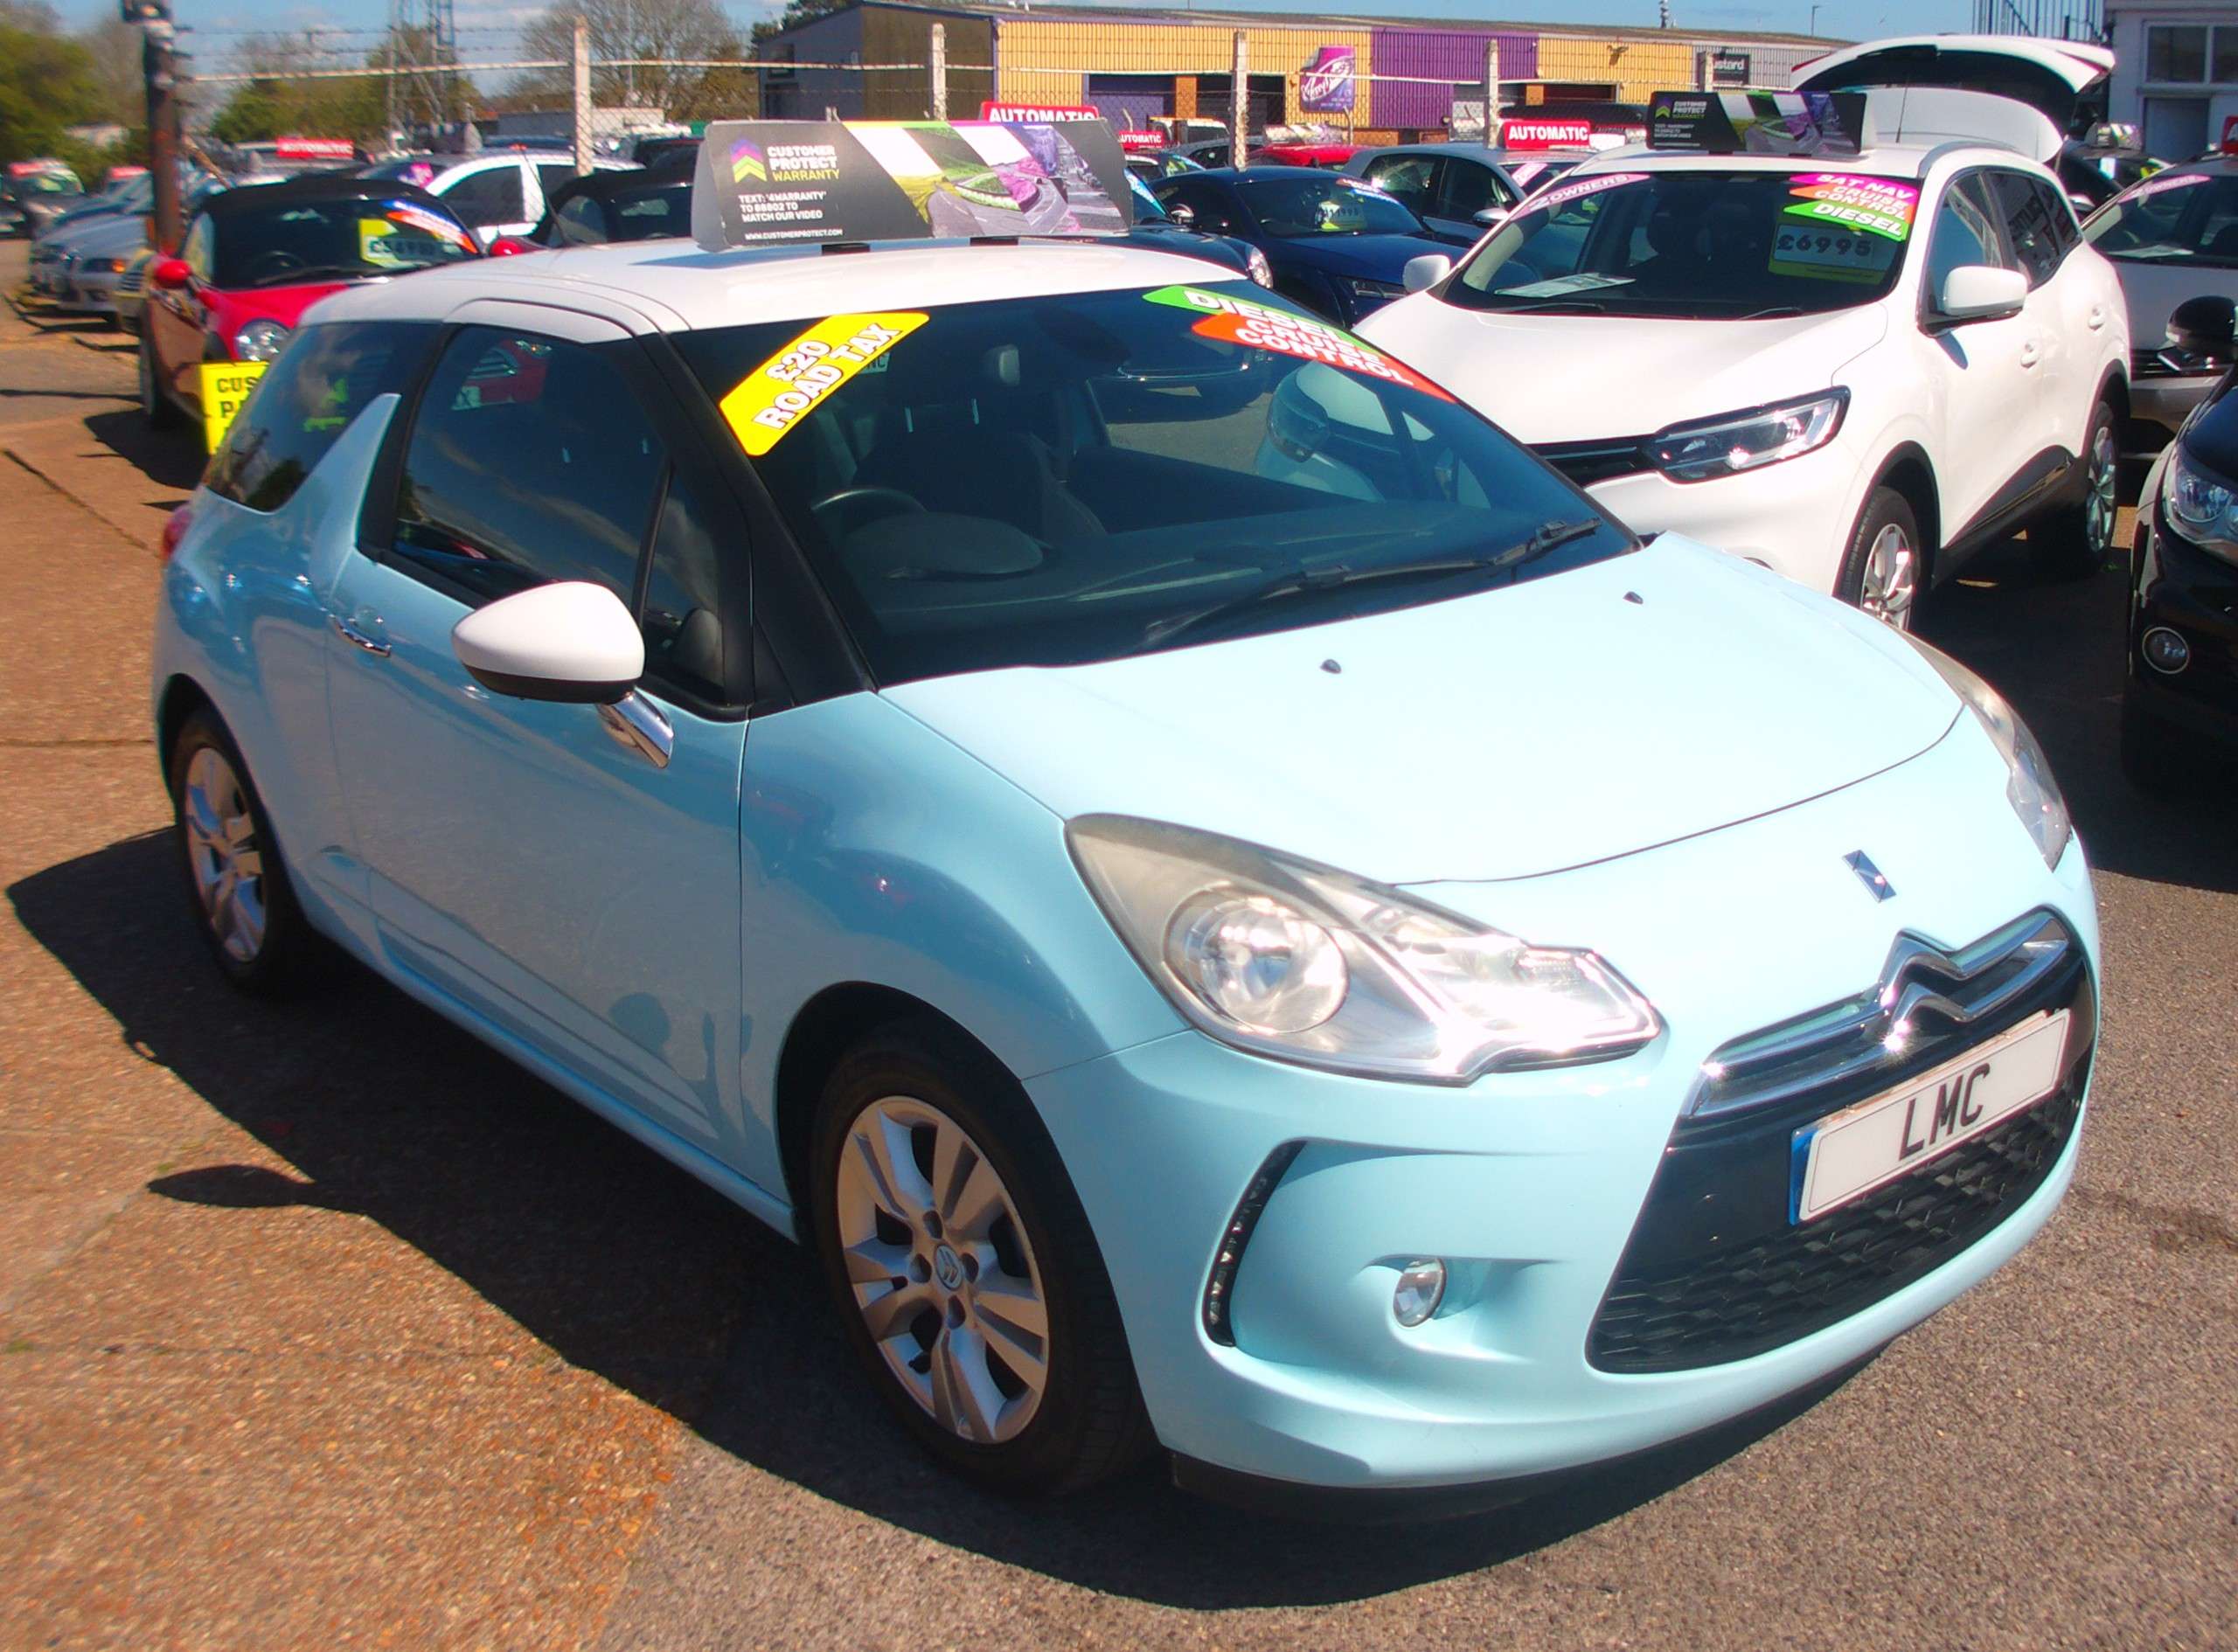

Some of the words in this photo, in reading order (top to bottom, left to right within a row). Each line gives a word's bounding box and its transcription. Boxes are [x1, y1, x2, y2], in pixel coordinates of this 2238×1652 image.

[1713, 58, 1745, 70] ustard
[1508, 125, 1588, 141] AUTOMATIC
[767, 145, 836, 157] CUSTOMER
[769, 156, 838, 170] PROTECT
[772, 169, 839, 182] WARRANTY
[1550, 175, 1629, 201] OWNERS
[1816, 174, 1864, 187] SAT
[1864, 180, 1914, 199] NAV
[740, 204, 754, 212] TO
[785, 201, 798, 211] TO
[1814, 191, 1906, 219] CONTROL
[1832, 185, 1909, 209] CRUISE
[741, 212, 775, 222] WATCH
[775, 211, 795, 220] OUR
[795, 210, 823, 219] VIDEO
[1812, 203, 1902, 236] DIESEL
[1776, 234, 1872, 256] £6995
[1184, 290, 1346, 342] DIESEL
[1246, 319, 1386, 364] CRUISE
[765, 340, 832, 382] £20
[1235, 328, 1414, 385] CONTROL
[752, 364, 844, 429] ROAD
[827, 323, 903, 363] TAX
[1898, 1062, 1991, 1162] LMC
